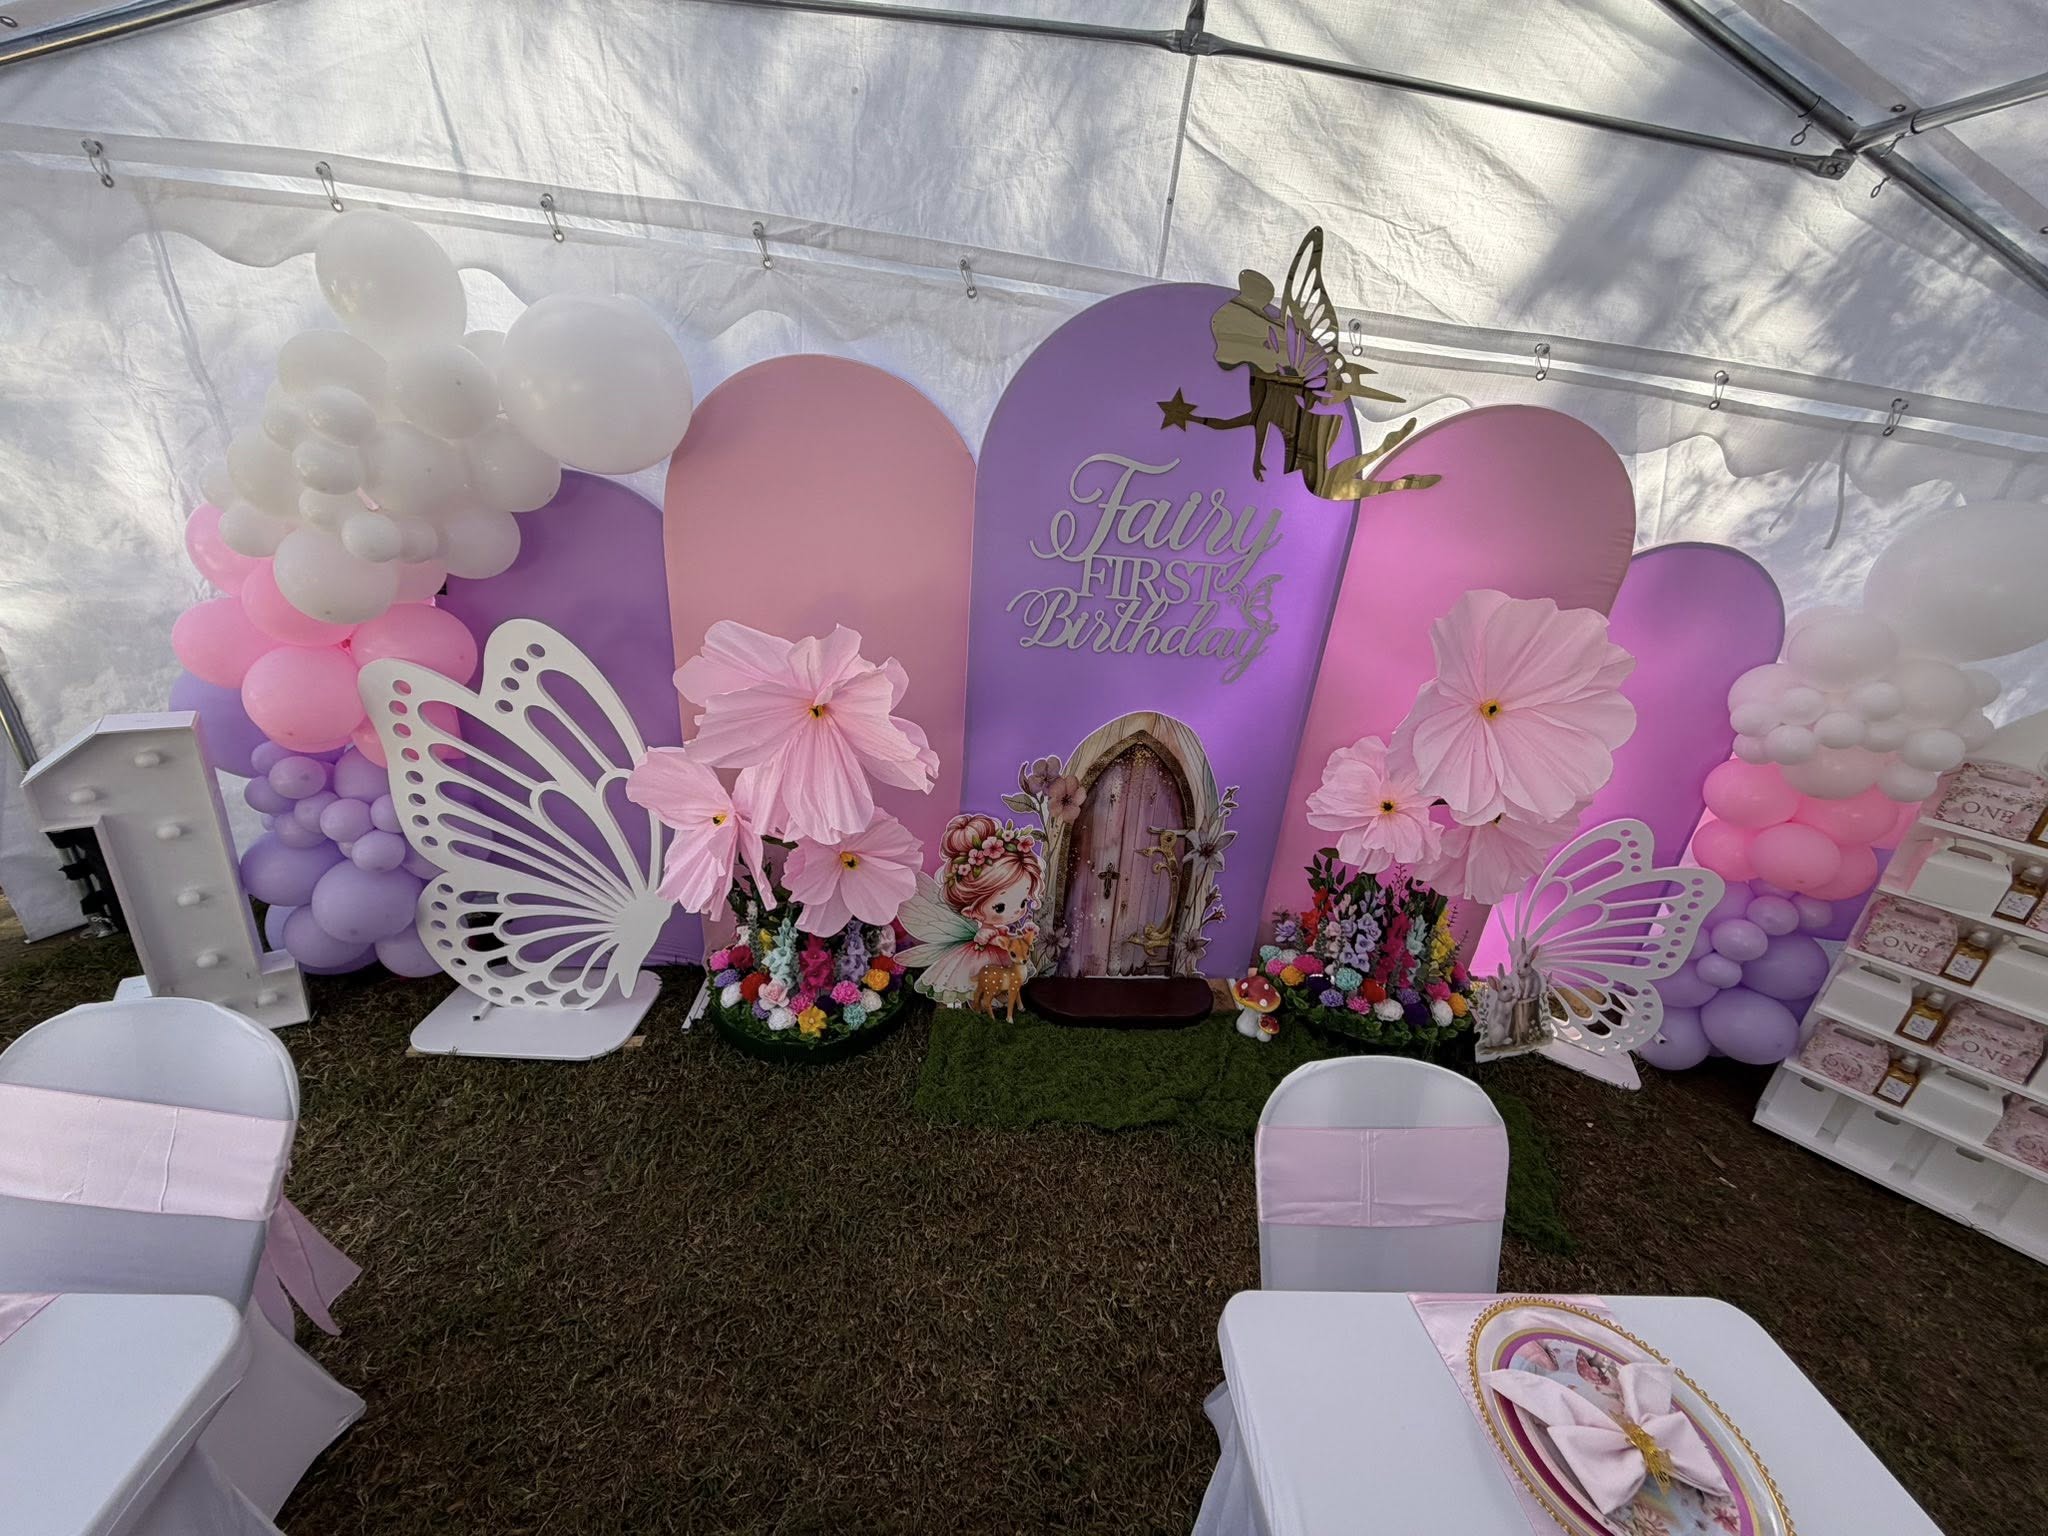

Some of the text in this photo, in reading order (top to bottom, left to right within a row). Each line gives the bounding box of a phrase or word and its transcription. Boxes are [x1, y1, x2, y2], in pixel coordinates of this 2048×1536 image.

[1029, 453, 1284, 591] Fairy
[1077, 554, 1229, 605] FIRST
[1005, 586, 1280, 685] Birthday
[1962, 801, 2015, 824] ONE
[1883, 935, 1930, 958] ONE
[1962, 1040, 2013, 1066] ONE
